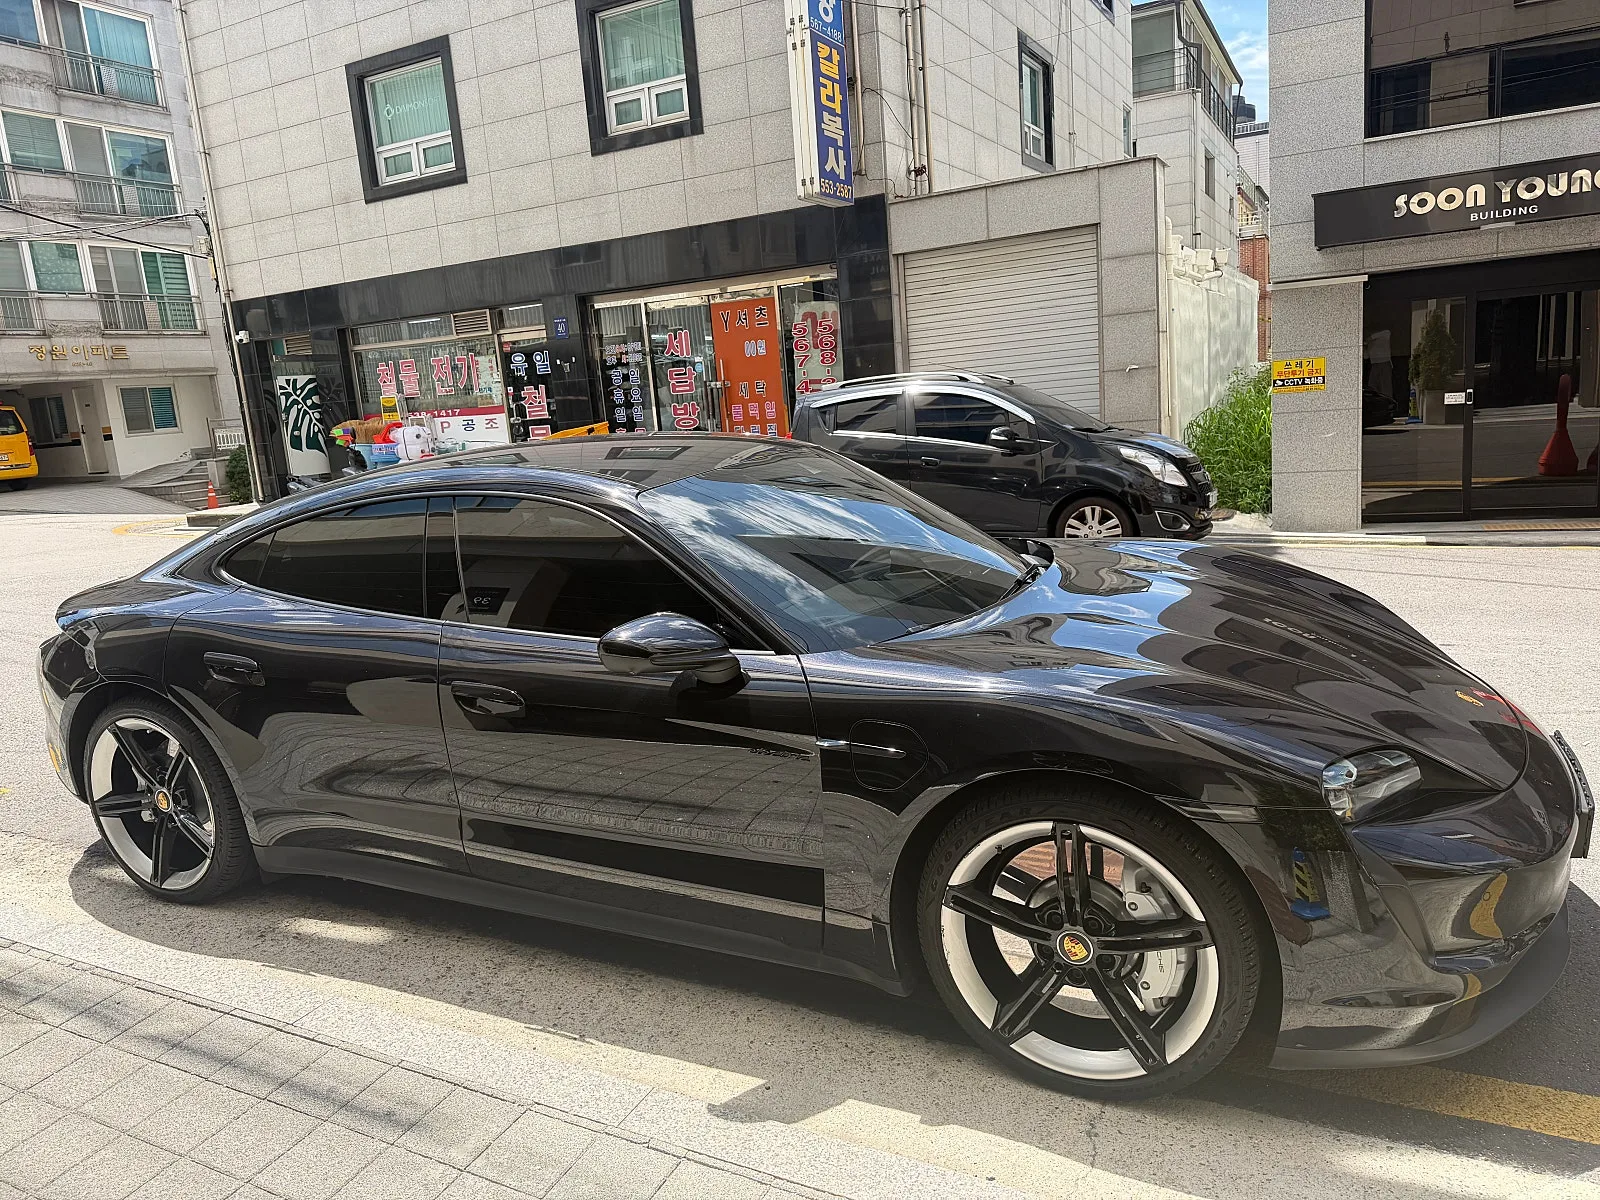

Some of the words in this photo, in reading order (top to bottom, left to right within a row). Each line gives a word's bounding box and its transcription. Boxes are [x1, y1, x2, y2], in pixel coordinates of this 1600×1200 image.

[810, 16, 842, 42] 567-4188
[816, 41, 847, 180] 칼라복사
[820, 178, 853, 200] 553-2587
[1393, 183, 1486, 218] SOON
[1470, 204, 1538, 222] BUILDING
[377, 359, 420, 398] 철물
[430, 352, 480, 396] 전기
[510, 350, 552, 377] 유일
[1283, 359, 1314, 370] 쓰레기
[664, 329, 700, 430] 세답방
[738, 380, 767, 399] 세탁
